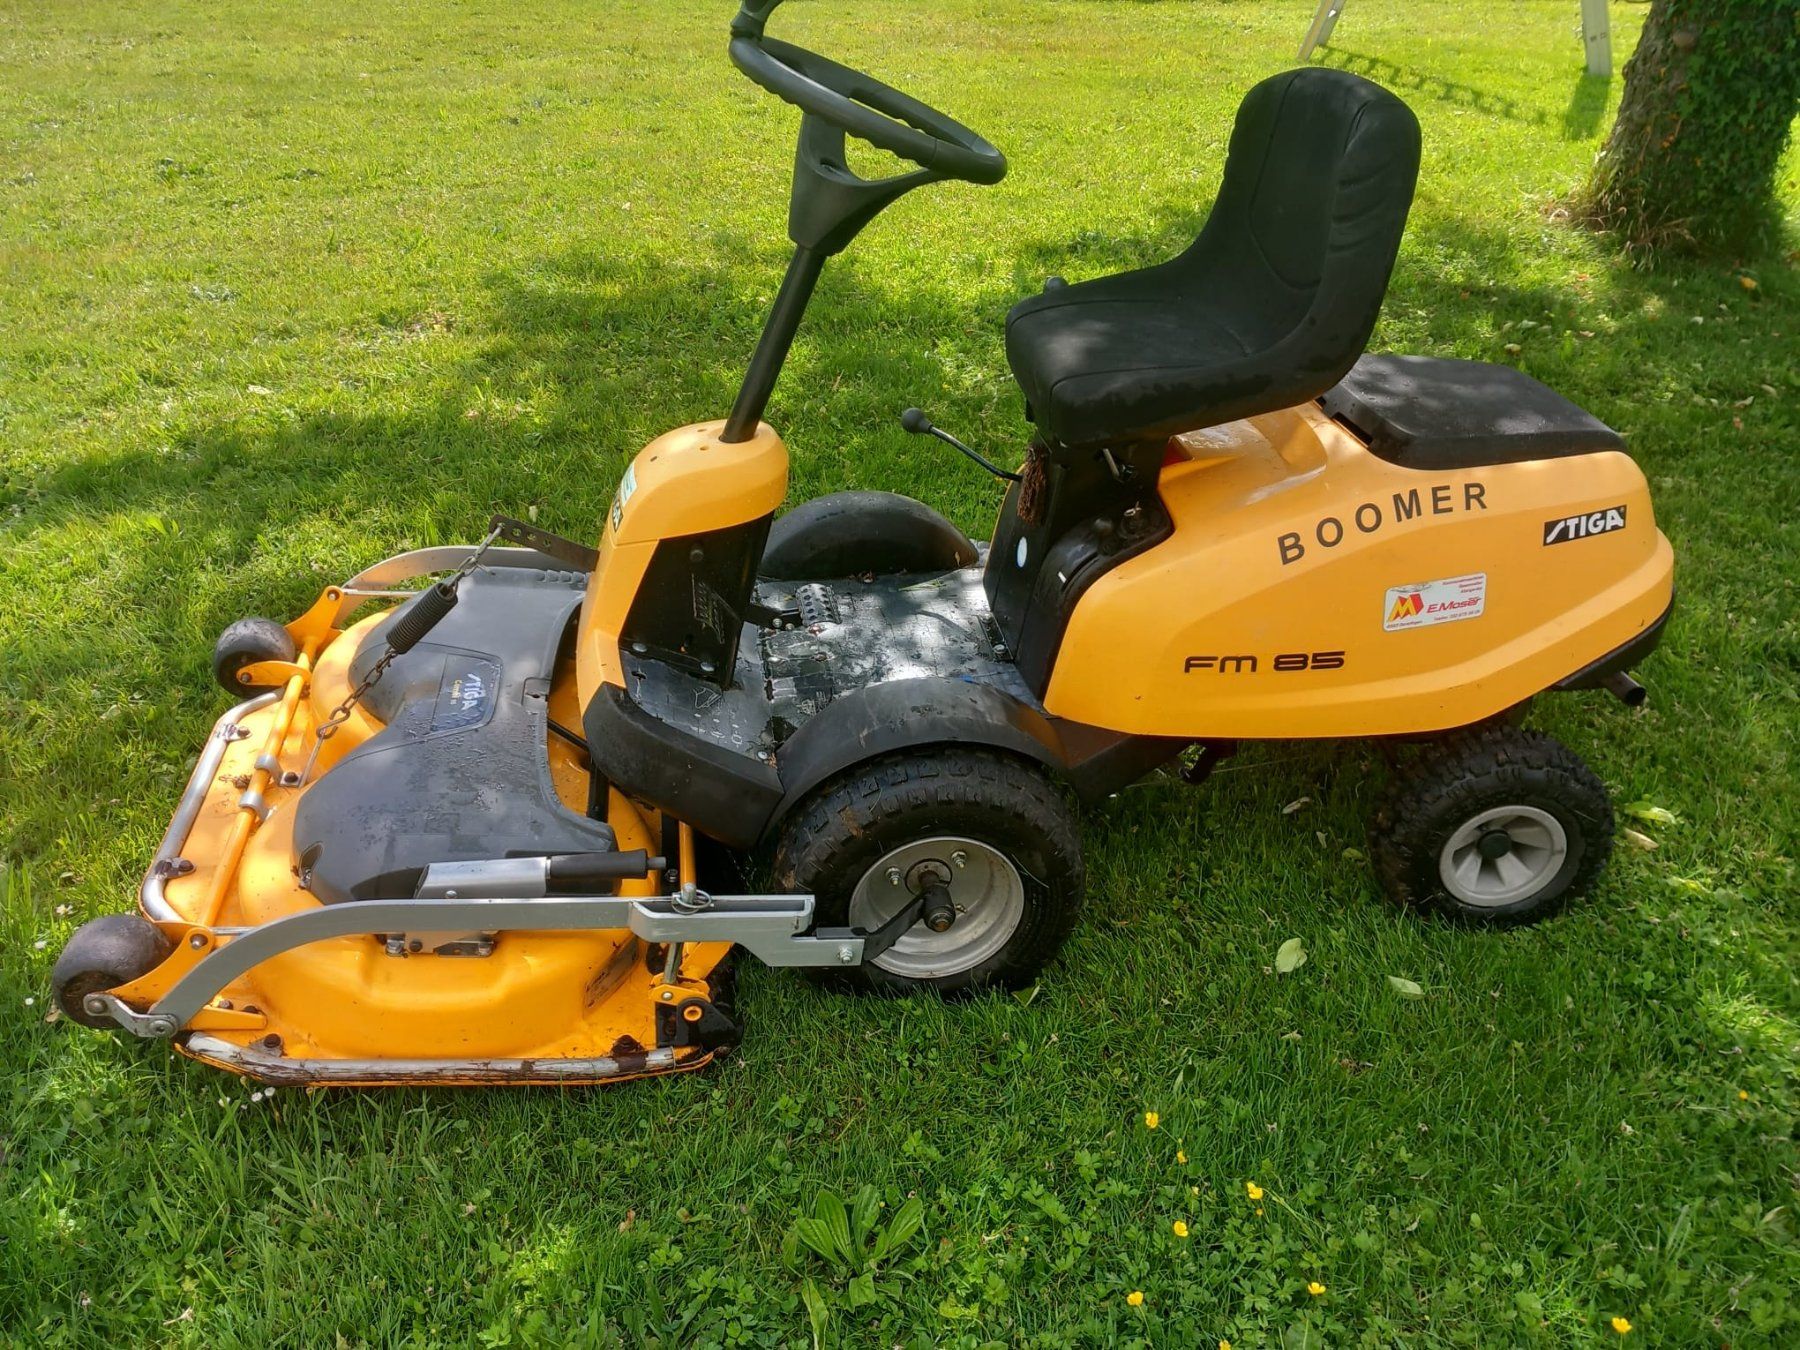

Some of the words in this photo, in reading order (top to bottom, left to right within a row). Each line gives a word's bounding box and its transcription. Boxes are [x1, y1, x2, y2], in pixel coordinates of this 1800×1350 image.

[1277, 482, 1488, 565] BOOMER
[1546, 509, 1624, 544] STIGA
[1273, 651, 1346, 671] 85
[461, 673, 482, 710] STIGA
